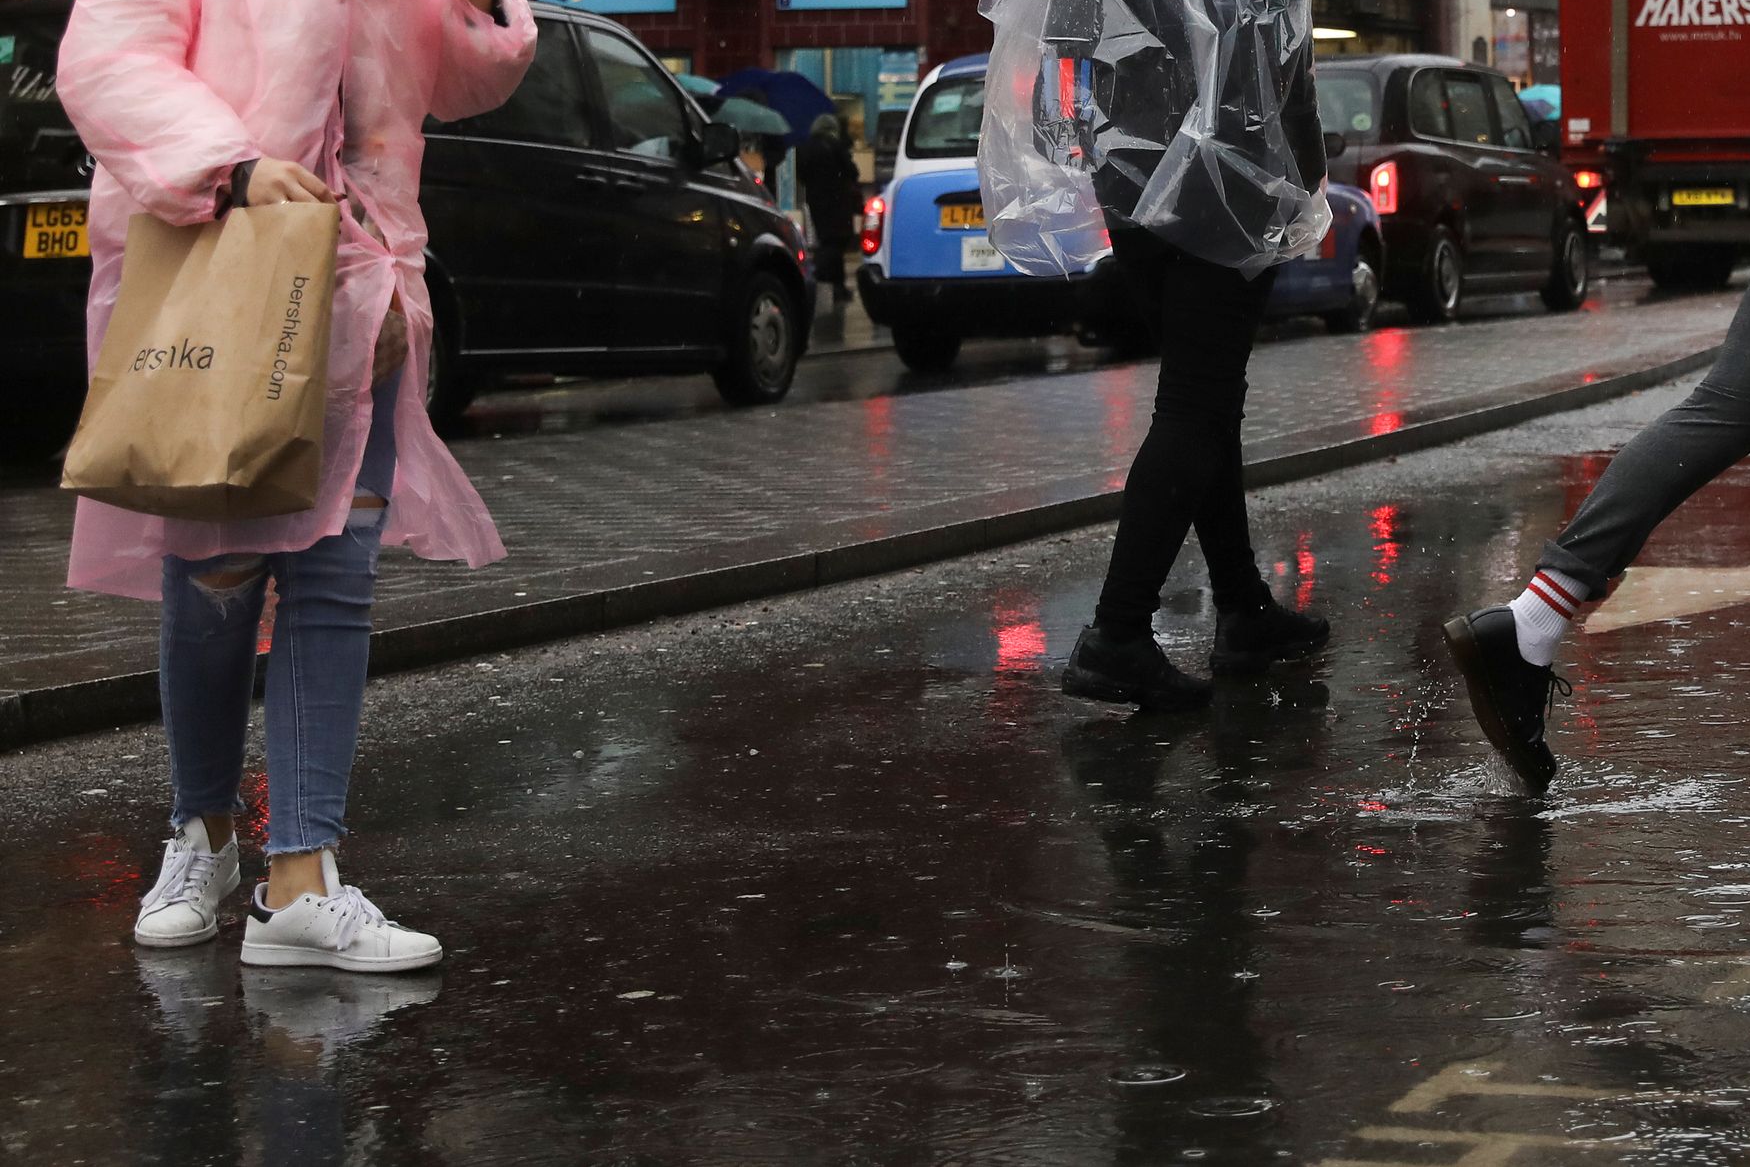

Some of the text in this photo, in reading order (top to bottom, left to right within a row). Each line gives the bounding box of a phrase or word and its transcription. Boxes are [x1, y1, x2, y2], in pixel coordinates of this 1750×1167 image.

[32, 204, 87, 228] LG63
[37, 231, 79, 253] BHO
[266, 275, 310, 401] bershka.com
